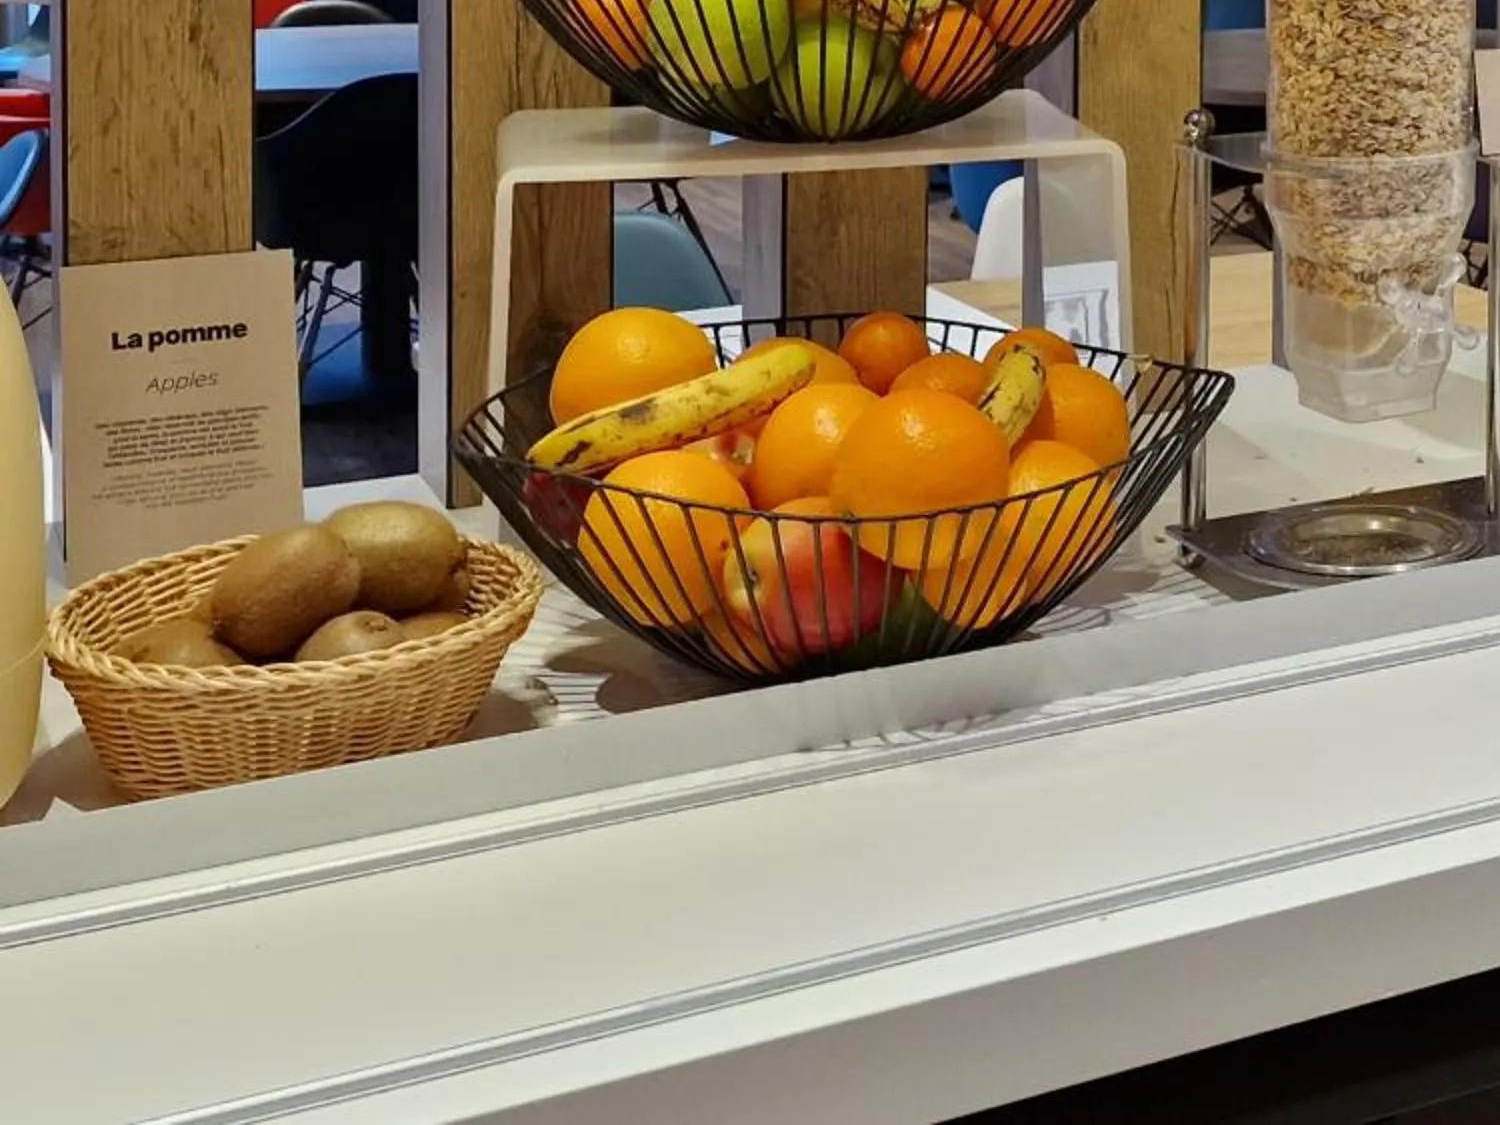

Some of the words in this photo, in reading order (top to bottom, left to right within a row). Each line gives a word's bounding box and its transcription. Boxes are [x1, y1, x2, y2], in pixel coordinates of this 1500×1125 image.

[111, 331, 143, 350] La
[149, 322, 248, 352] pomme
[145, 372, 219, 395] Apples
